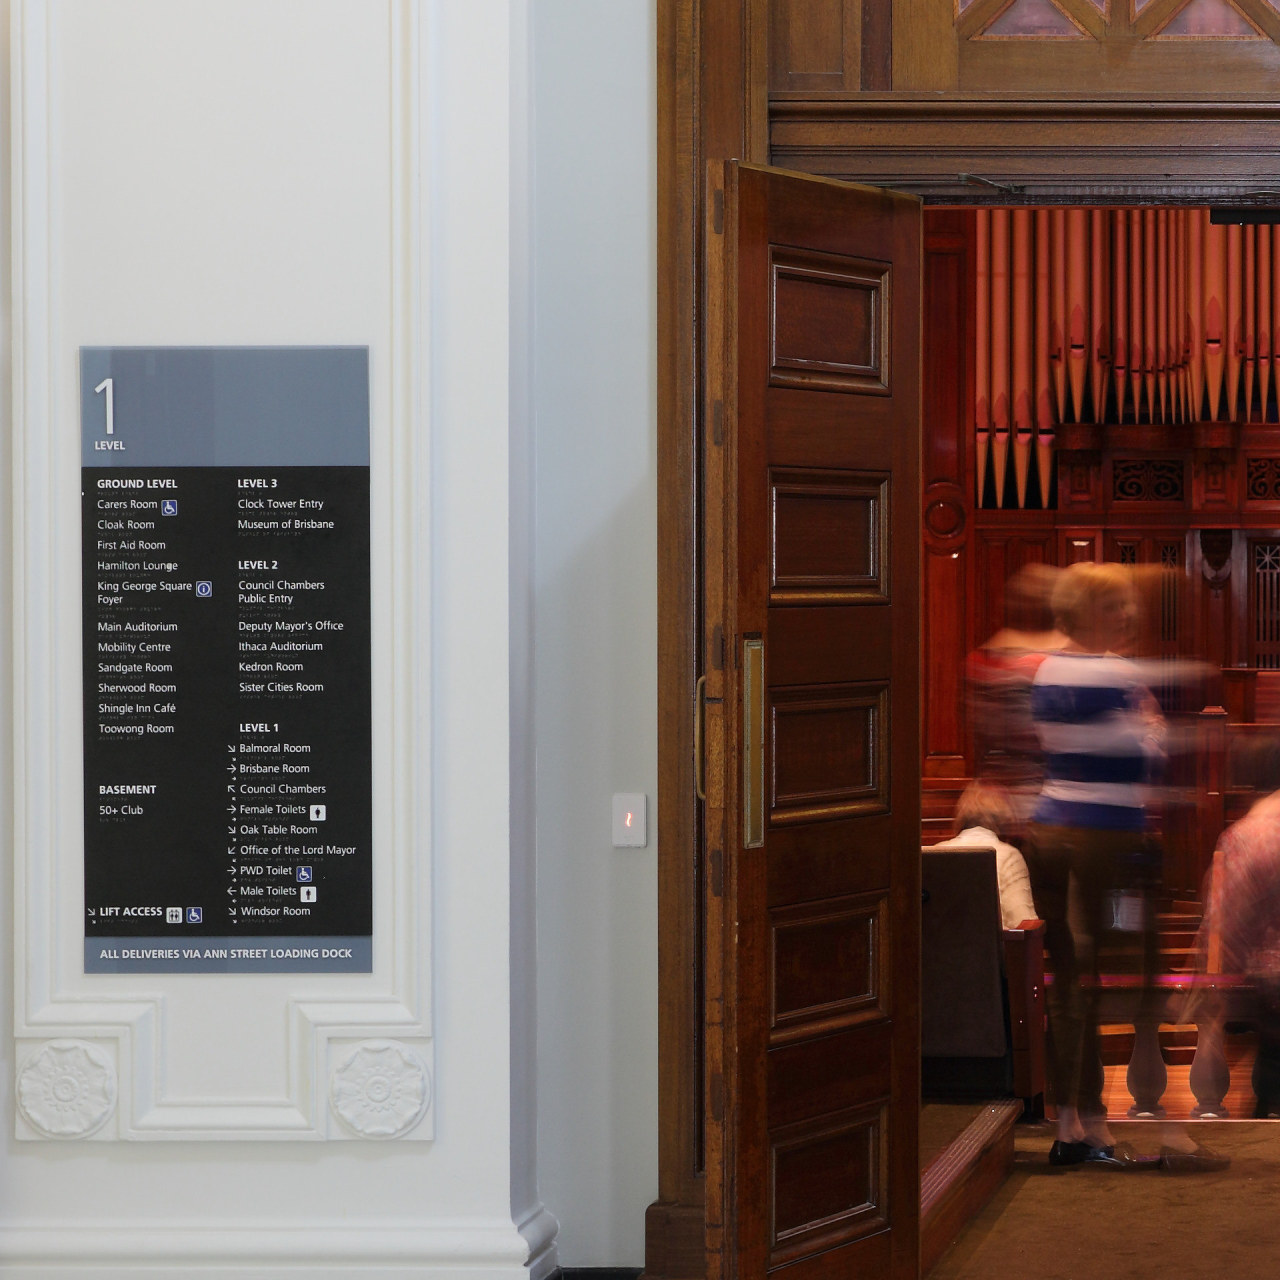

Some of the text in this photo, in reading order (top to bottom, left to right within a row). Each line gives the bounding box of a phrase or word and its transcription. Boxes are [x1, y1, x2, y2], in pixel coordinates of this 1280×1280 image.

[94, 378, 114, 435] 1
[94, 440, 126, 451] LEVEL
[96, 479, 178, 489] GROUND LEVEL
[237, 478, 278, 489] LEVEL 3
[97, 499, 158, 509] Carers Room
[237, 498, 324, 511] Clock Tower Entry
[97, 519, 155, 530] Cloak Room
[237, 518, 335, 529] Museum of Brisbane
[97, 540, 166, 550] First Aid Room
[97, 560, 179, 573] Hamilton Lounge
[238, 560, 278, 570] LEVEL 2
[97, 580, 193, 593] King George Square
[238, 579, 325, 590] Council Chambers
[97, 594, 124, 606] Foyer
[238, 593, 294, 605] Public Entry
[97, 621, 178, 632] Main Auditorium
[238, 620, 344, 633] Deputy Mayor's Office
[98, 642, 171, 654] Mobility Centre
[238, 641, 323, 651] Ithaca Auditorium
[98, 662, 173, 675] Sandgate Room
[238, 661, 304, 672] Kedron Room
[98, 682, 177, 693] Sherwood Room
[239, 682, 324, 692] Sister Cities Room
[98, 702, 177, 716] Shingle Inn Café
[98, 723, 175, 736] Toowong Room
[239, 723, 279, 733] LEVEL 1
[239, 743, 311, 753] Balmoral Room
[239, 763, 310, 774] Brisbane Room
[99, 784, 157, 795] BASEMENT
[239, 783, 327, 794] Council Chambers
[99, 804, 144, 815] 50+ Club
[240, 804, 307, 814] Female Toilets
[240, 824, 318, 835] Oak Table Room
[240, 844, 357, 857] Office of the Lord Mayor
[240, 865, 293, 876] PWD Toilet
[240, 885, 297, 896] Male Toilets
[99, 906, 163, 917] LIFT ACCESS
[240, 906, 311, 916] Windsor Room
[99, 948, 353, 959] ALL DELIVERIES VIA ANN STREET LOADING DOCK
